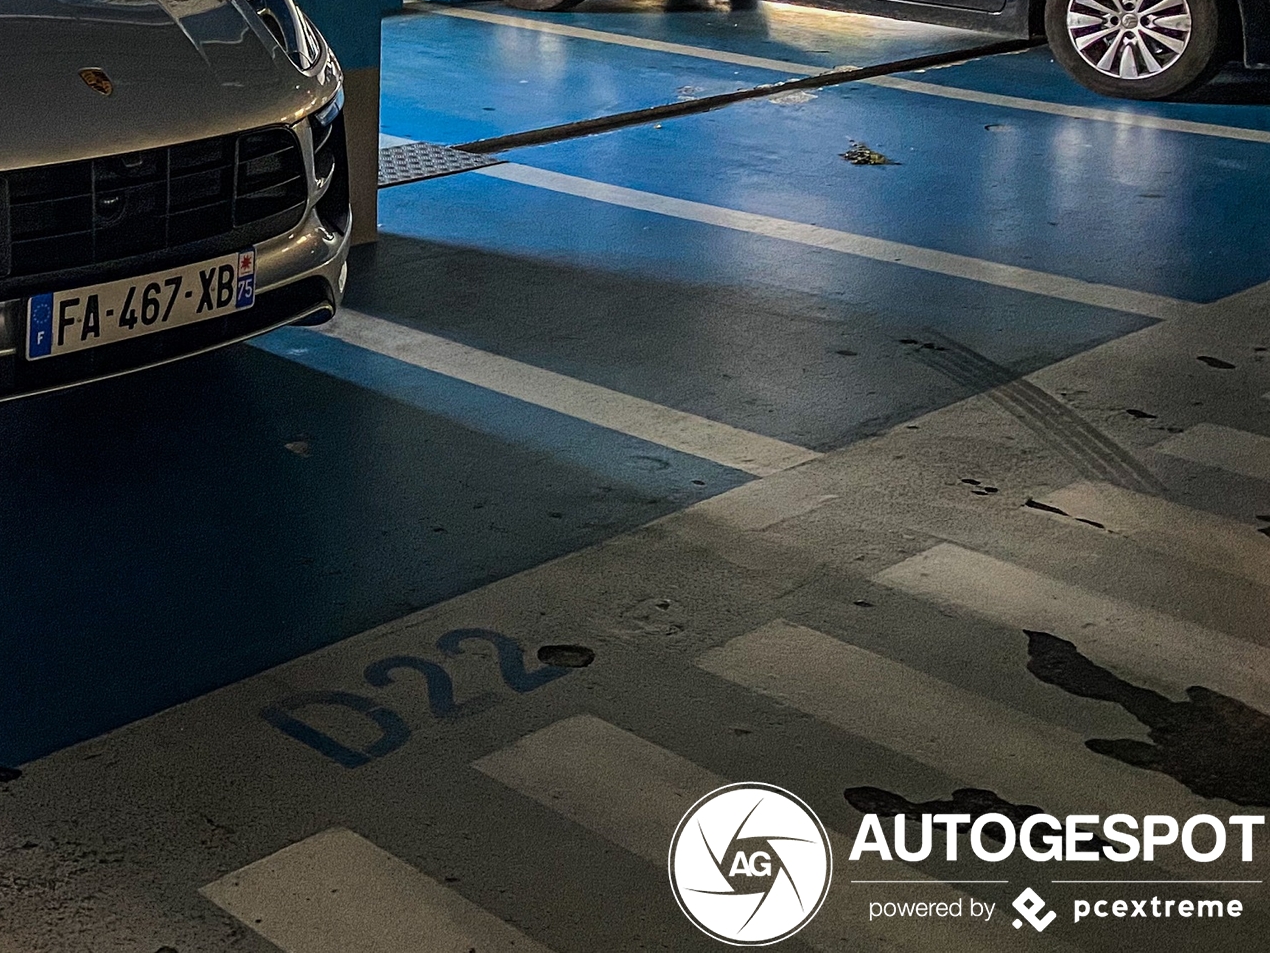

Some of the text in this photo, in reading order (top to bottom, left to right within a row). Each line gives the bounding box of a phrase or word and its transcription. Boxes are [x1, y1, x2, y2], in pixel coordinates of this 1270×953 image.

[37, 263, 253, 346] F FA-467-XB 75
[259, 627, 575, 769] D22
